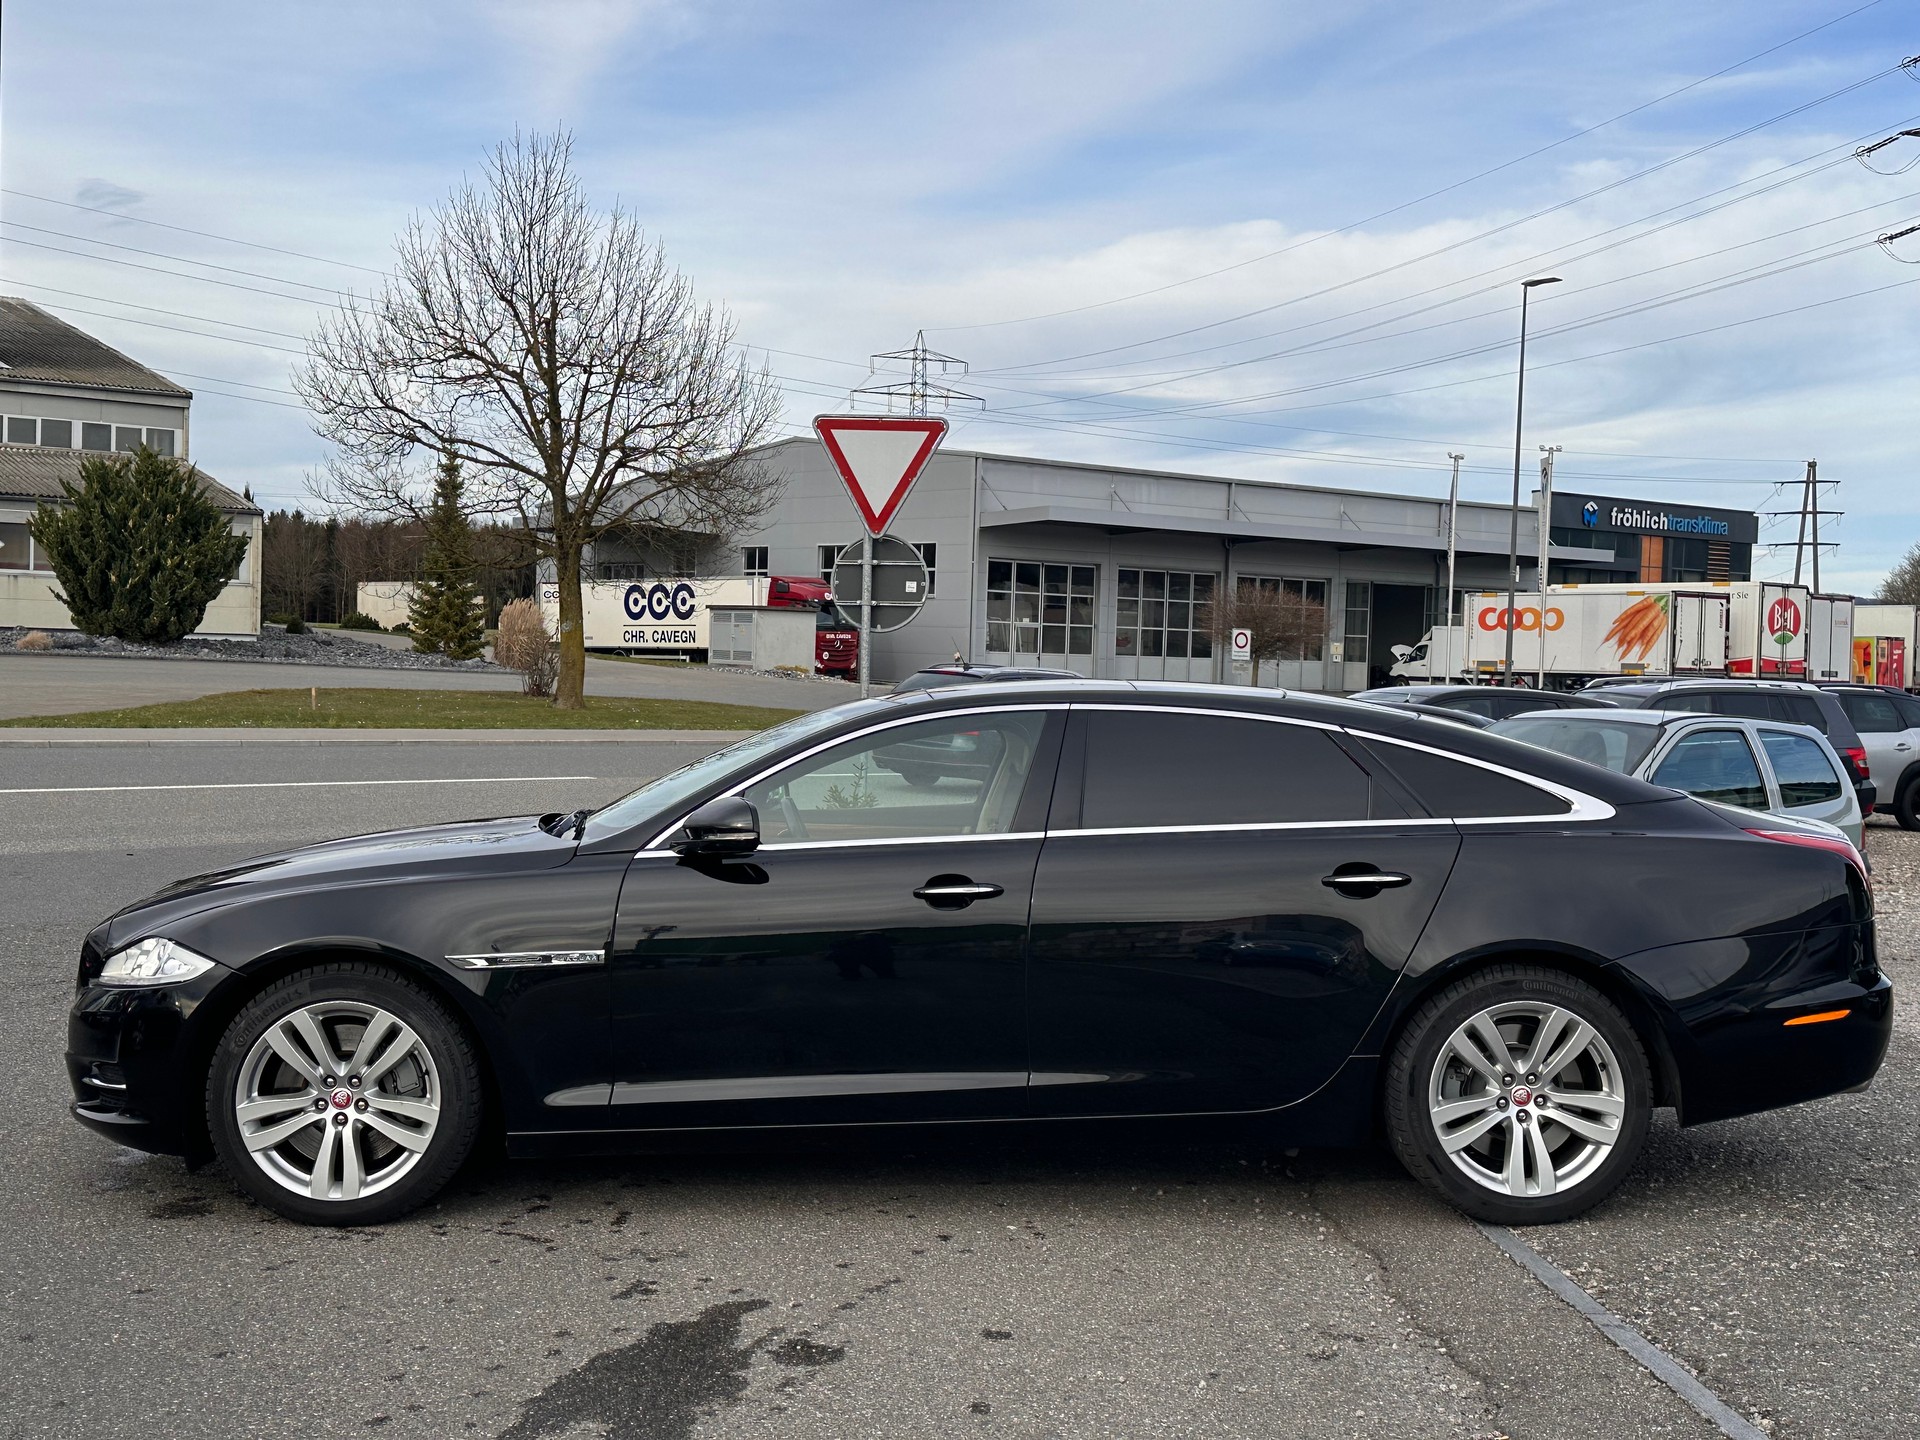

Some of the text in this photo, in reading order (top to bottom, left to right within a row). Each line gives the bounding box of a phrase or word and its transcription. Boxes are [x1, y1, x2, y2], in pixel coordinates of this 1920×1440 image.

[624, 583, 695, 620] CCC
[1478, 607, 1565, 638] coop
[623, 630, 696, 643] CHR. CAVEGN
[1522, 979, 1579, 1000] Continental
